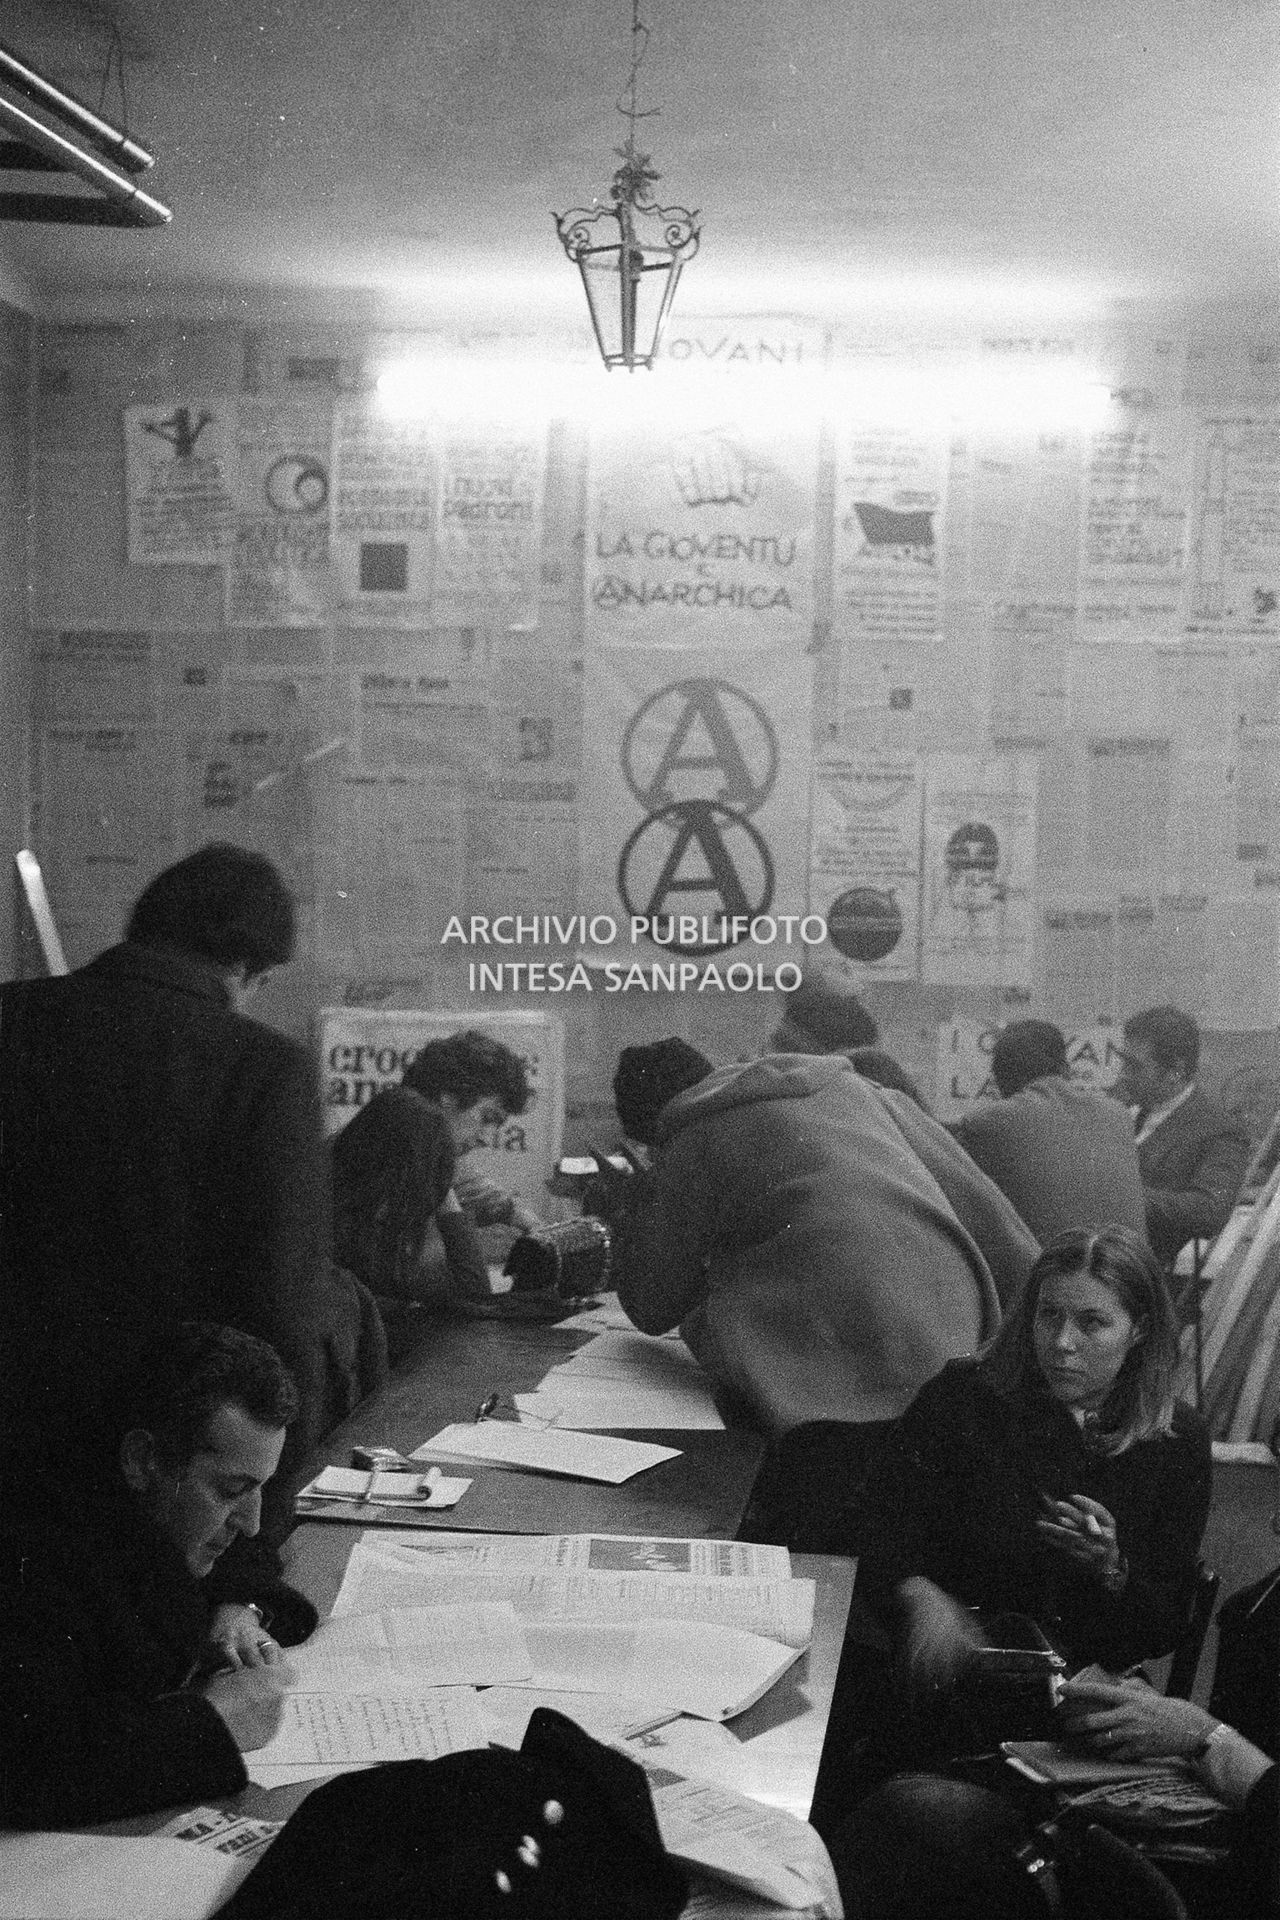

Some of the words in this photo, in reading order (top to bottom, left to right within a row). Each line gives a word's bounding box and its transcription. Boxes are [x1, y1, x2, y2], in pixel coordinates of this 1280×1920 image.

[668, 335, 804, 365] OVANI
[595, 531, 634, 559] LA
[643, 528, 797, 568] GIOVENTU
[592, 574, 793, 613] ANARCHICA
